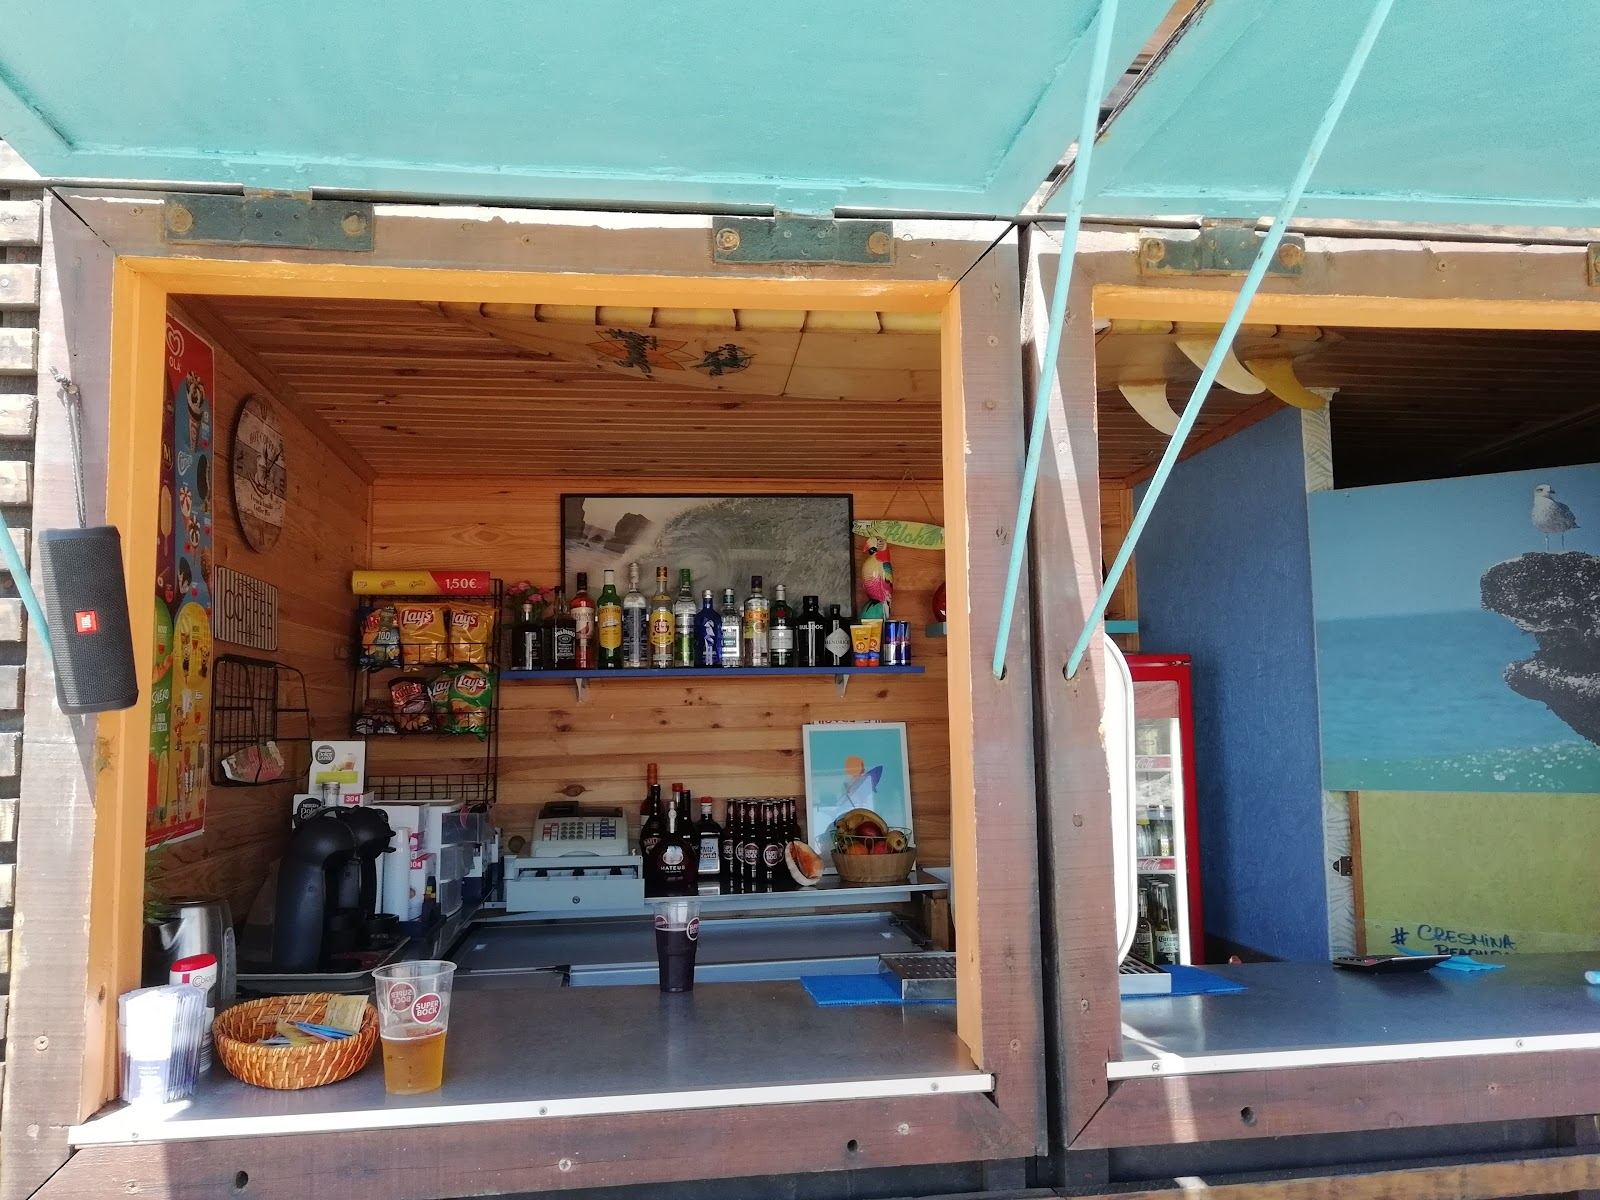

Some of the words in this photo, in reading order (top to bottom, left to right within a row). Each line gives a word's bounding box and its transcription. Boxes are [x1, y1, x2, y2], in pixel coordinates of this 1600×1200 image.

[168, 357, 182, 373] OLA
[445, 578, 478, 590] 1,50€
[1391, 927, 1410, 945] #
[415, 1000, 439, 1010] SUPER
[416, 1007, 438, 1017] BOCK
